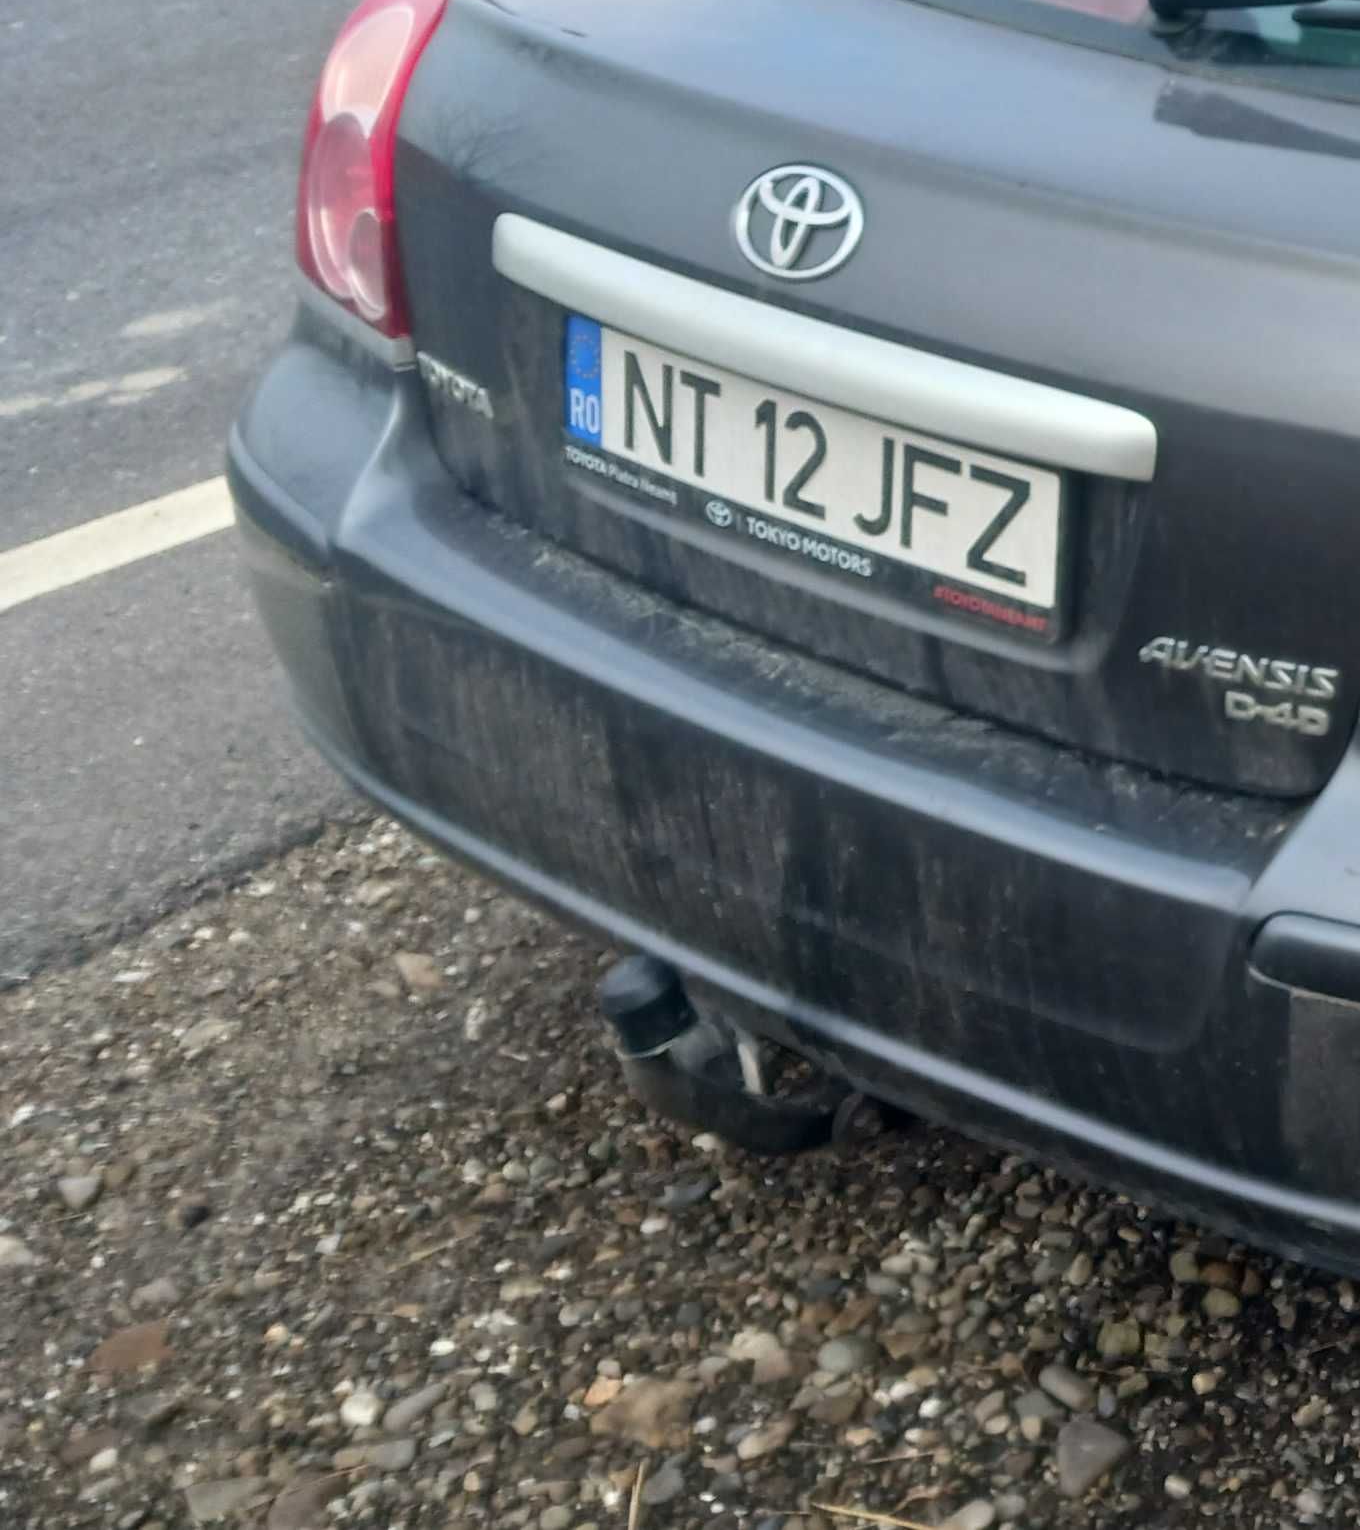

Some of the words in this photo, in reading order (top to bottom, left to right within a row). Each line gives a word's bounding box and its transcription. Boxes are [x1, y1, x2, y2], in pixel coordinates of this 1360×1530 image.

[569, 386, 601, 437] RO
[564, 445, 607, 474] TOYOTA
[622, 351, 721, 475] NT
[753, 398, 828, 522] 12
[854, 434, 1032, 585] JFZ
[746, 517, 800, 551] TOKYO
[802, 538, 873, 577] MOTORS
[1138, 635, 1340, 699] AVENSIS
[1224, 690, 1330, 736] D-4D
